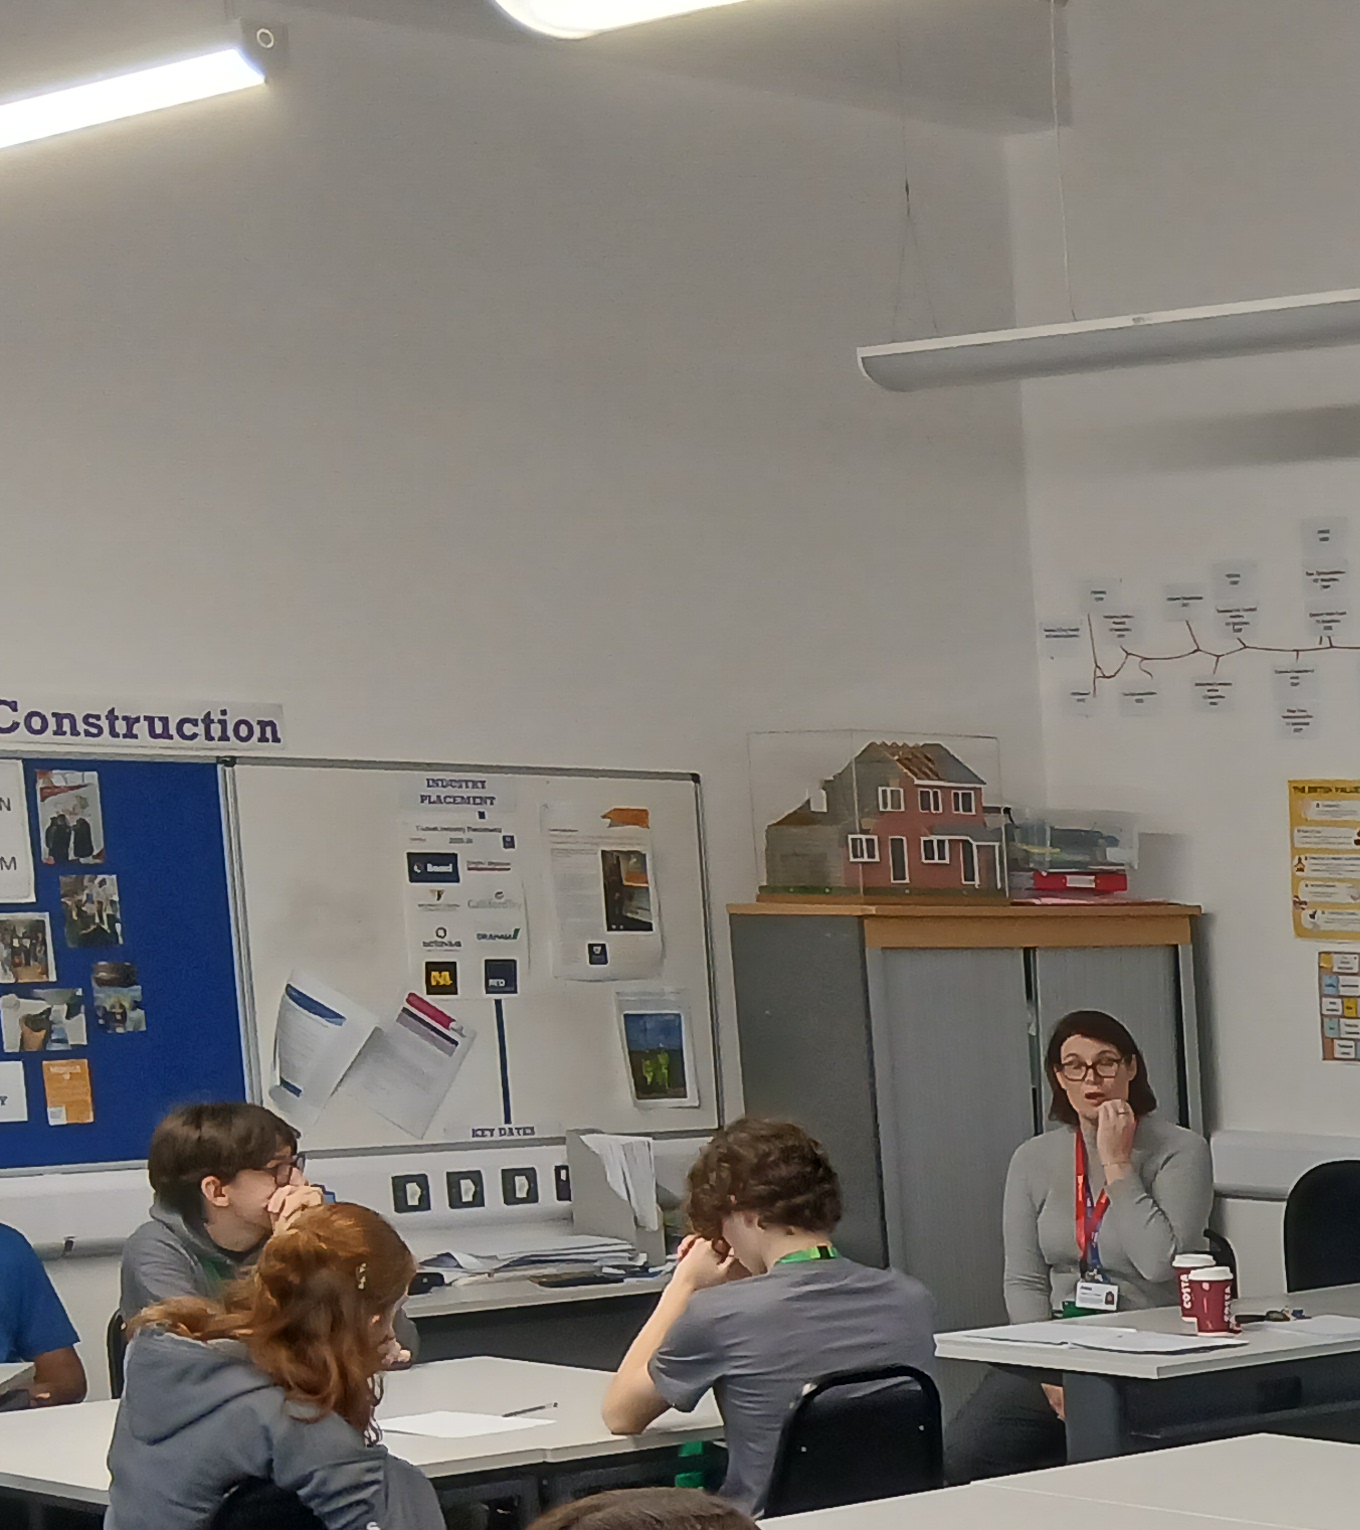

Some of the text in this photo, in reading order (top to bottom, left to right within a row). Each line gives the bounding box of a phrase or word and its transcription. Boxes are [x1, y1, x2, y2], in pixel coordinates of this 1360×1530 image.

[0, 700, 281, 743] Construction
[420, 794, 496, 806] PLACEMENT
[472, 1126, 535, 1138] KEY DATES
[1180, 1274, 1192, 1309] COSTA
